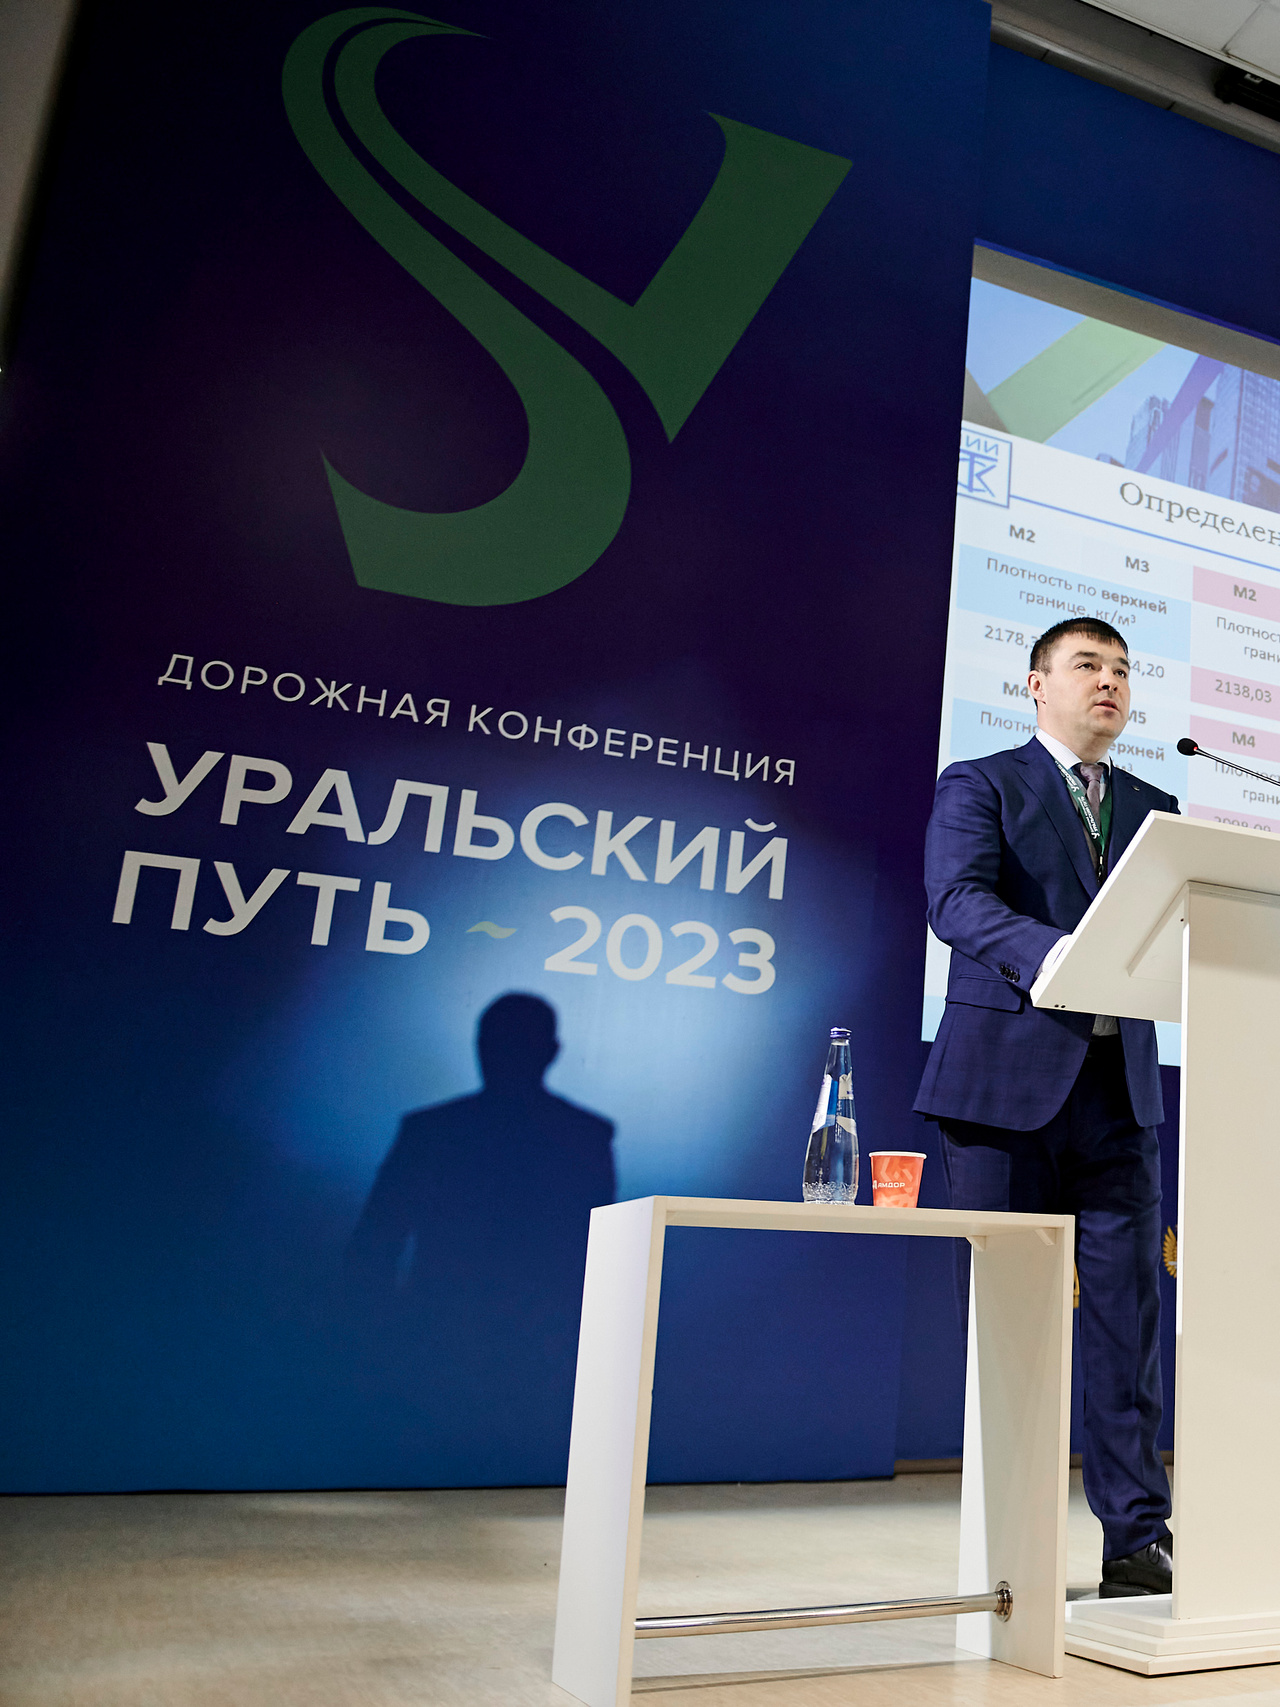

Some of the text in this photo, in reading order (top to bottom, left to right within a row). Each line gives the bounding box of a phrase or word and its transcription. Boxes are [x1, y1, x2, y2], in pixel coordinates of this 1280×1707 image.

[1009, 524, 1036, 543] М2
[1125, 555, 1150, 573] М3
[987, 557, 1168, 616] Плотность по верхней
[1233, 584, 1257, 602] М2
[1003, 682, 1030, 699] М4
[1215, 679, 1272, 703] 2138,03
[157, 652, 796, 786] ДОРОЖНАЯ КОНФЕРЕНЦИЯ
[1232, 731, 1256, 748] М4
[133, 741, 788, 900] УРАЛЬСКИЙ
[111, 850, 776, 995] ПУТЬ 2023
